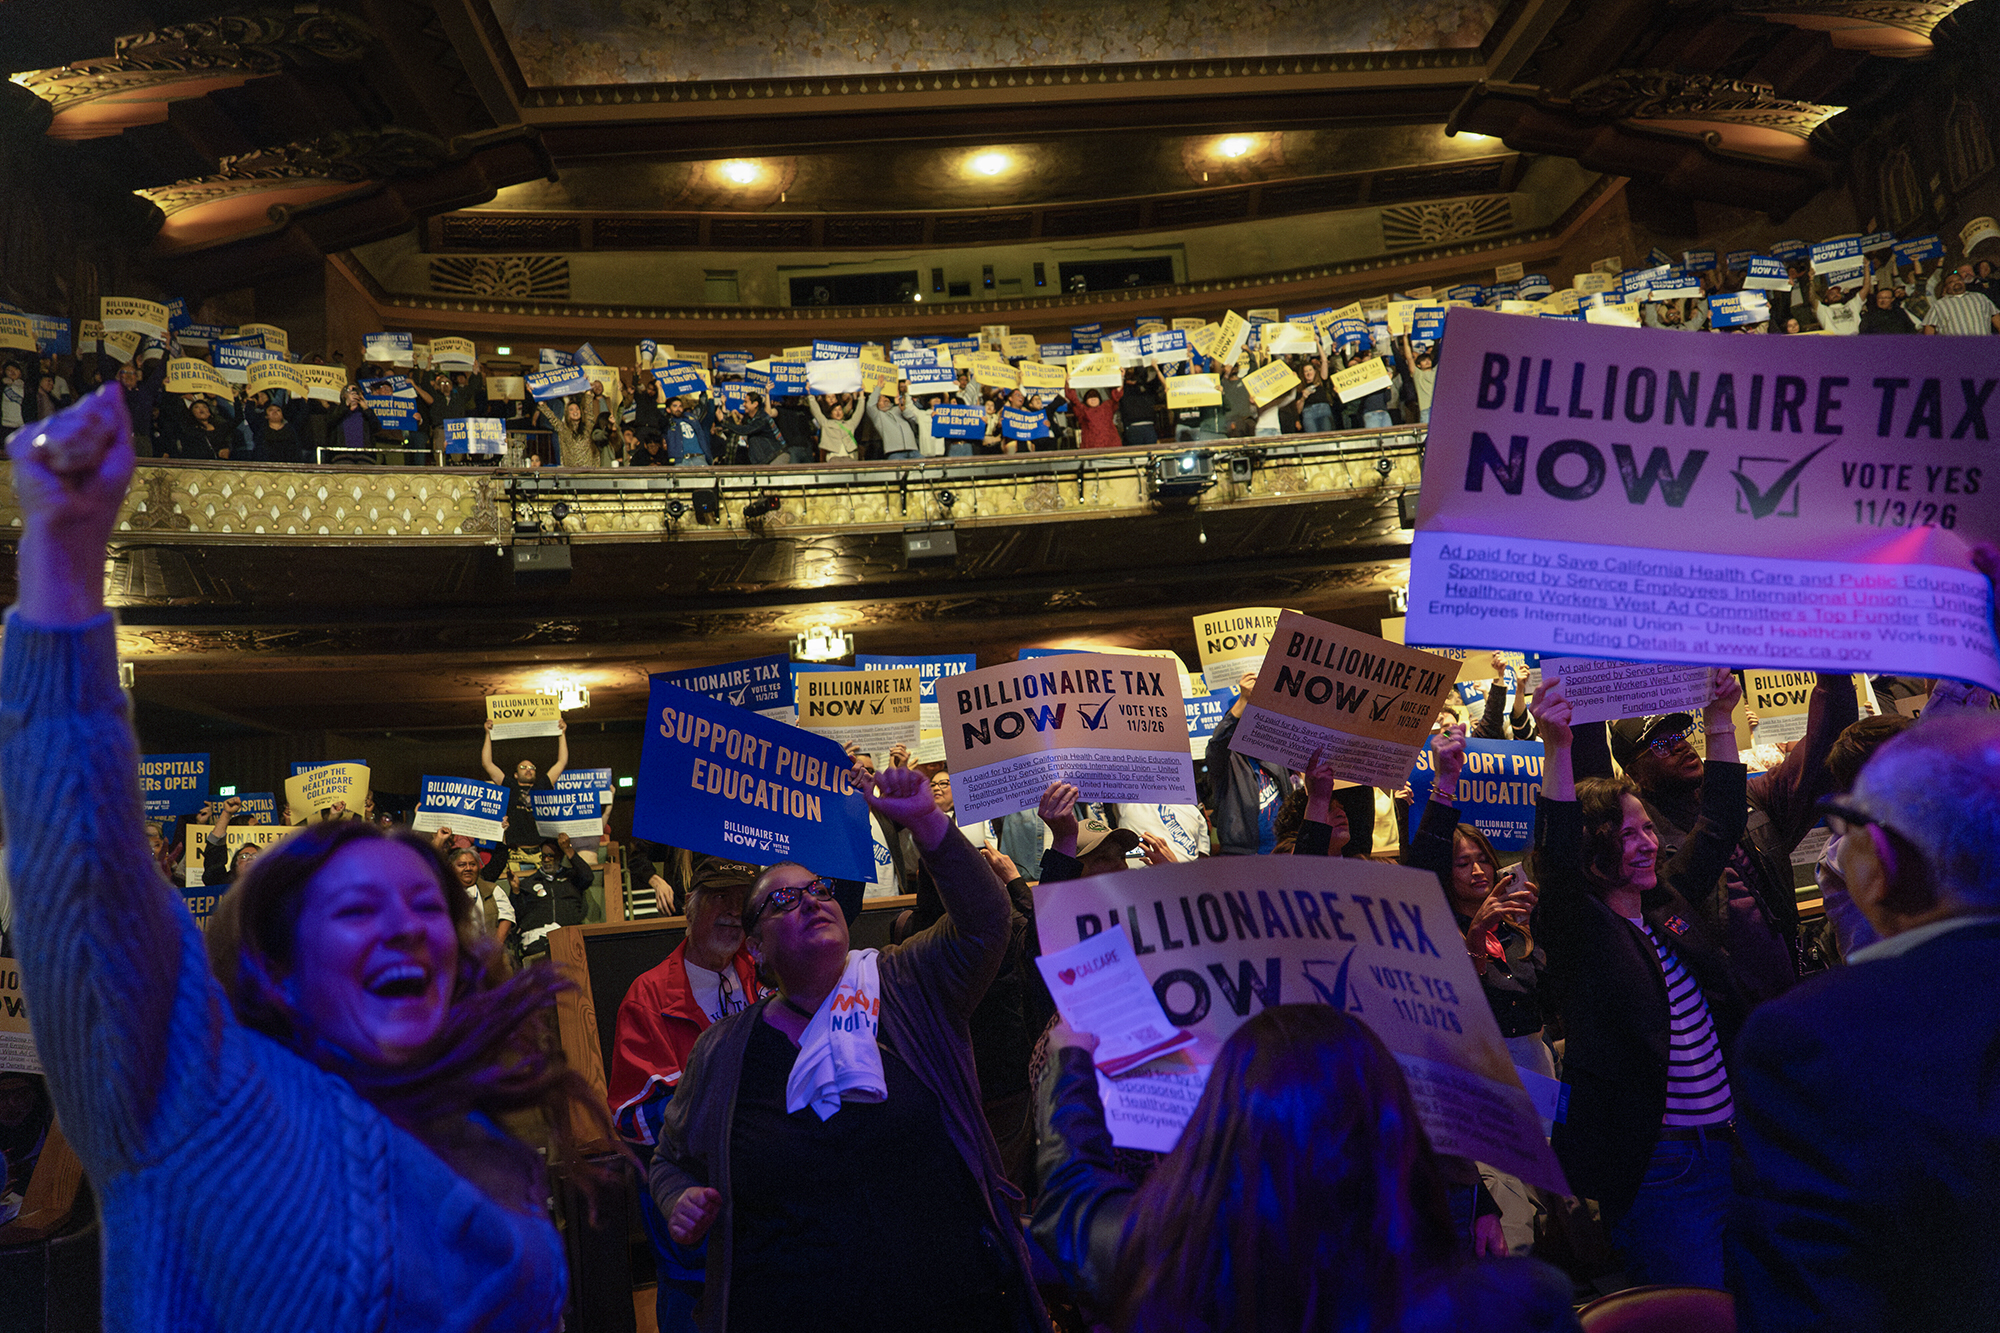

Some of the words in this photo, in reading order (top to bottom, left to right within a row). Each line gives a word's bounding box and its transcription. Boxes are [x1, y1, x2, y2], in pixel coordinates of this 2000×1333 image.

[1814, 250, 1836, 261] NOW
[1750, 266, 1771, 275] NOW
[106, 300, 151, 311] BILLIONAIRE
[152, 304, 164, 316] TAX
[106, 308, 135, 316] NOW
[220, 346, 266, 360] BILLIONAIRE
[220, 356, 248, 366] NOW
[815, 351, 838, 360] NOW
[170, 362, 192, 370] FOOD
[772, 366, 787, 374] KEEP
[534, 378, 549, 386] AND
[562, 372, 580, 382] OPEN
[776, 374, 788, 382] AND
[910, 374, 931, 382] NOW
[1339, 378, 1360, 388] NOW
[1476, 352, 1850, 436] BILLIONAIRE
[1872, 376, 2000, 441] TAX
[936, 407, 950, 416] KEEP
[950, 408, 984, 418] HOSPITALS
[447, 422, 465, 432] KEEP
[938, 416, 950, 424] AND
[951, 417, 962, 425] ERs
[962, 418, 980, 426] OPEN
[452, 431, 466, 440] AND
[1464, 431, 1709, 508] NOW
[1841, 461, 1913, 491] VOTE
[1925, 466, 1983, 495] YES
[1853, 499, 1958, 530] 11/3/26
[1440, 544, 1461, 560] Ad
[1467, 547, 1500, 563] paid
[1506, 548, 1526, 563] for
[1532, 550, 1550, 568] by
[1557, 553, 1599, 569] Save
[1604, 557, 1684, 578] California
[1690, 563, 1746, 582] Health
[1750, 570, 1795, 587] Care
[1800, 572, 1832, 588] and
[1840, 574, 1898, 589] Public
[1448, 563, 1536, 584] Sponsored
[1541, 569, 1561, 589] by
[1566, 571, 1628, 592] Service
[1634, 578, 1729, 600] Employees
[1735, 586, 1847, 606] International
[1852, 591, 1908, 608] Union
[1208, 633, 1258, 654] NOW
[1554, 628, 1621, 649] Funding
[1627, 634, 1687, 653] Details
[754, 663, 780, 681] TAX
[944, 662, 966, 677] TAX
[1286, 631, 1416, 690] BILLIONAIRE
[1414, 668, 1446, 697] TAX
[751, 684, 767, 694] VOTE
[768, 682, 781, 692] YES
[809, 678, 890, 696] BILLIONAIRE
[893, 678, 912, 692] TAX
[1564, 684, 1612, 697] Healthcare
[1614, 678, 1648, 692] Workers
[1754, 672, 1816, 690] BILLIONAI
[956, 670, 1116, 715] BILLIONAIRE
[1120, 670, 1165, 697] TAX
[1274, 665, 1370, 714] NOW
[492, 698, 538, 709] BILLIONAIRE
[540, 697, 554, 706] TAX
[1622, 702, 1658, 714] Funding
[1659, 698, 1684, 710] Details
[1758, 690, 1807, 709] NOW
[494, 708, 524, 719] NOW
[809, 700, 865, 716] NOW
[1118, 704, 1146, 718] VOTE
[1148, 705, 1168, 718] YES
[1400, 700, 1420, 712] VOTE
[1416, 704, 1430, 716] YES
[962, 703, 1067, 750] NOW
[1126, 720, 1165, 732] 11/3/26
[1254, 712, 1264, 720] Ad
[1265, 715, 1281, 727] paid
[1282, 720, 1292, 729] for
[1292, 723, 1301, 734] by
[1300, 726, 1318, 738] Save
[1396, 715, 1421, 729] 11/3/26
[660, 707, 772, 770] SUPPORT
[776, 746, 854, 796] PUBLIC
[308, 770, 329, 782] STOP
[331, 768, 346, 776] THE
[595, 772, 608, 780] TAX
[963, 776, 973, 785] Ad
[974, 771, 990, 784] paid
[991, 769, 1000, 778] for
[1002, 766, 1012, 776] by
[1013, 760, 1032, 772] Save
[1033, 753, 1068, 767] California
[1070, 753, 1093, 762] Health
[1094, 754, 1112, 762] Care
[1113, 754, 1126, 762] and
[1127, 755, 1148, 763] Public
[165, 773, 198, 790] OPEN
[302, 776, 353, 793] HEALTHCARE
[557, 780, 582, 790] NOW
[306, 786, 348, 800] COLLAPSE
[427, 781, 486, 799] BILLIONAIRE
[488, 788, 503, 802] TAX
[534, 793, 576, 805] BILLIONAIRE
[578, 792, 594, 803] TAX
[691, 758, 822, 823] EDUCATION
[426, 794, 462, 808] NOW
[536, 805, 560, 818] NOW
[724, 820, 773, 840] BILLIONAIRE
[775, 832, 790, 844] TAX
[1475, 820, 1514, 829] BILLIONAIRE
[1516, 822, 1528, 830] TAX
[723, 832, 757, 849] NOW
[1351, 894, 1440, 959] TAX
[1075, 950, 1120, 978] CALCARE
[1151, 958, 1281, 1027] OW
[1369, 964, 1420, 994] VOTE
[1420, 976, 1460, 1006] YES
[1391, 996, 1464, 1036] 11/3/26
